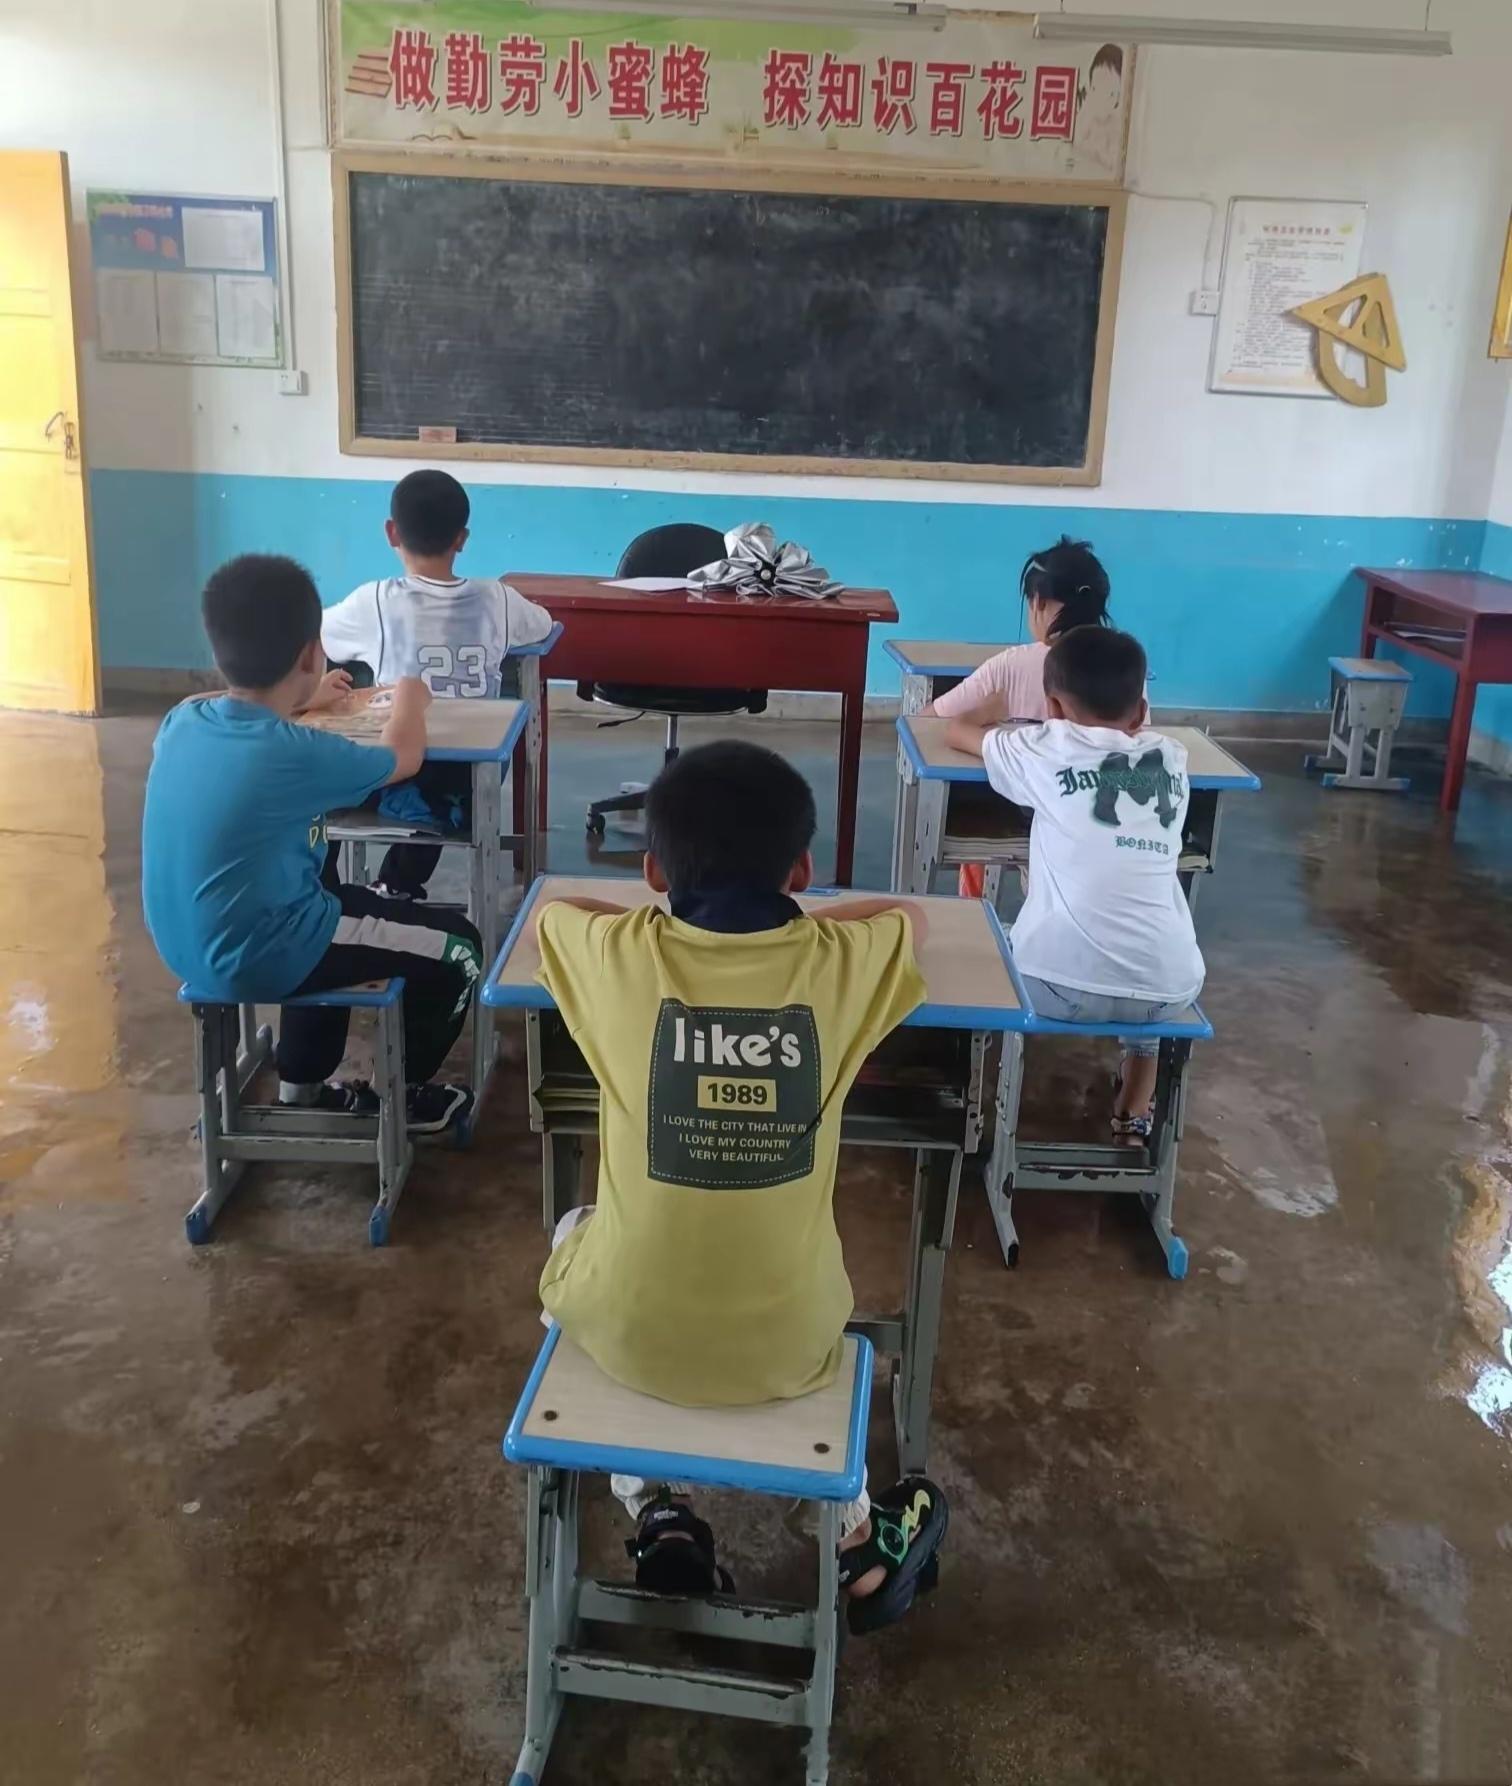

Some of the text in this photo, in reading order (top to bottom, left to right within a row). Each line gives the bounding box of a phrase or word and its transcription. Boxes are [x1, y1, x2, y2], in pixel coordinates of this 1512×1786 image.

[387, 28, 1077, 140] 做勤劳小蜜蜂 探知识百花园
[416, 645, 488, 698] 23
[1115, 836, 1169, 855] BONITA
[707, 1083, 768, 1105] 1989
[669, 1115, 695, 1128] LOVE
[698, 1119, 718, 1130] THE
[721, 1120, 744, 1131] CITY
[747, 1122, 775, 1132] THAT
[777, 1123, 796, 1133] LIVE
[798, 1124, 807, 1134] IN
[685, 1134, 715, 1146] LOVE
[718, 1137, 736, 1147] MY
[739, 1138, 791, 1149] COUNTRY
[689, 1149, 719, 1160] VERY
